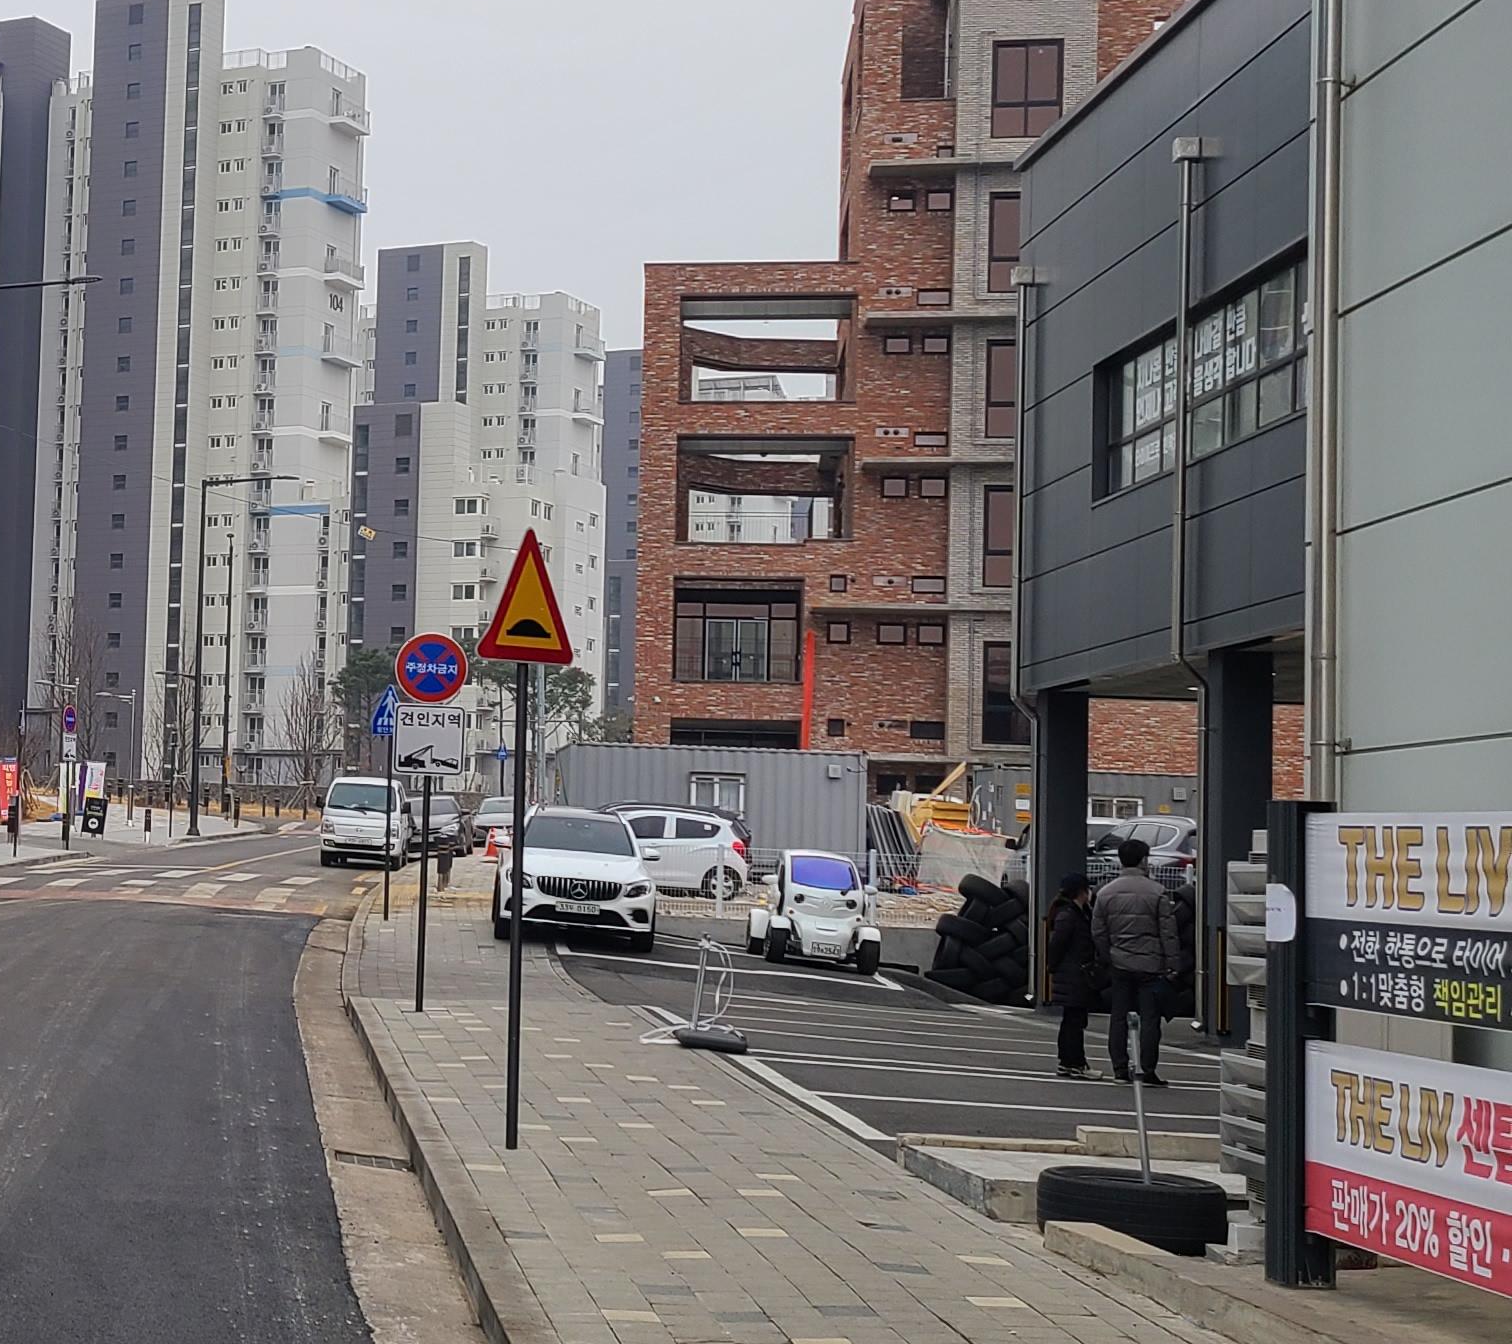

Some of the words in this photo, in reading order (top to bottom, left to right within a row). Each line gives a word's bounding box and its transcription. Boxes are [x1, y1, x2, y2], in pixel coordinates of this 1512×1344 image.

[329, 294, 343, 312] 104
[406, 662, 458, 675] 주정차금지
[399, 711, 461, 729] 견인지역
[1338, 825, 1425, 911] THE
[1436, 825, 1512, 917] LIV
[1350, 929, 1380, 965] 전화
[1384, 931, 1448, 969] 한통으로
[1453, 938, 1508, 978] 타이어
[1352, 971, 1425, 1013] 1:1맞춤형
[1433, 978, 1502, 1022] 책임관리
[1330, 1068, 1395, 1155] THE
[1399, 1083, 1455, 1168] LIV
[1331, 1179, 1389, 1246] 판매가
[1395, 1200, 1439, 1258] 20%
[1446, 1210, 1492, 1279] 할인
